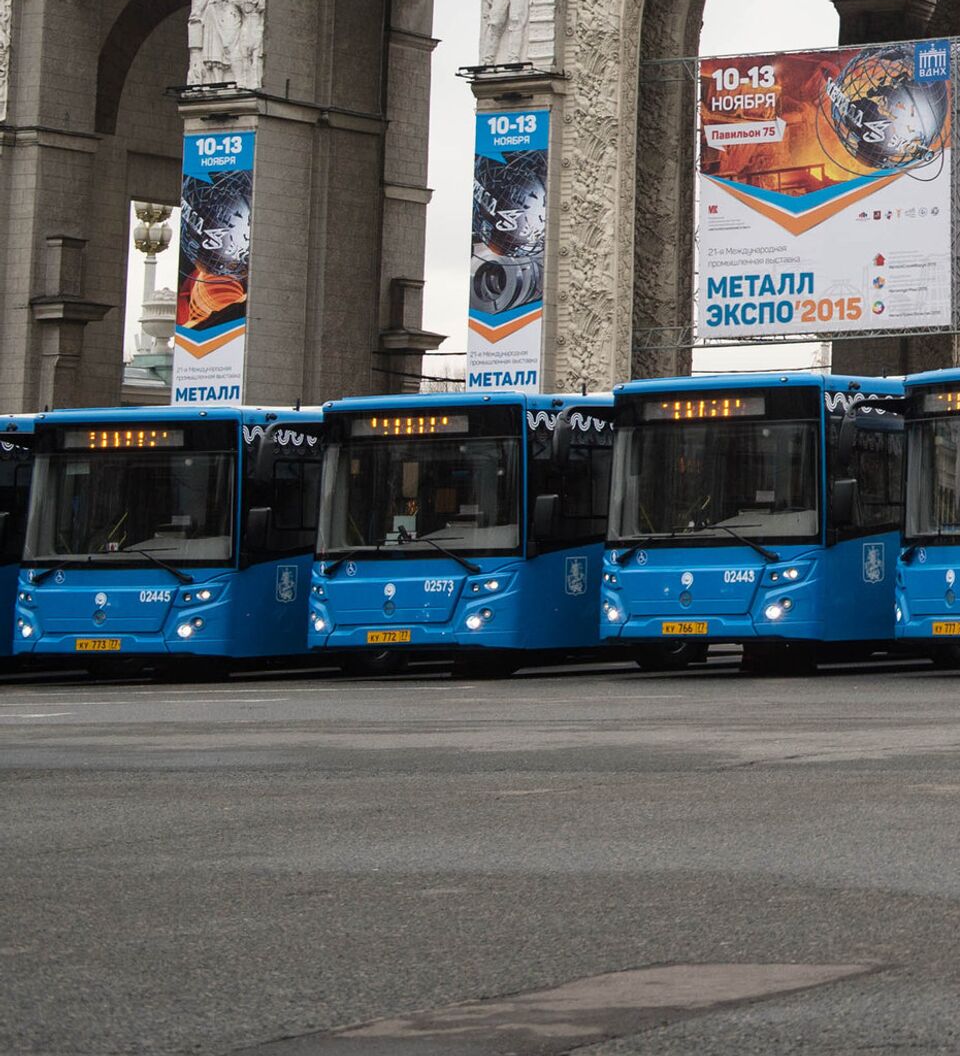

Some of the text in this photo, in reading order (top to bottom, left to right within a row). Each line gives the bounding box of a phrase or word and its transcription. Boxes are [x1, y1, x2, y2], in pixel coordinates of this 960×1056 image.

[712, 65, 775, 91] 10-13
[919, 69, 947, 77] ВДНХ
[712, 93, 776, 112] НОЯБРЯ
[488, 115, 537, 134] 10-13
[712, 127, 775, 140] Павильон 75
[196, 136, 242, 155] 10-13
[494, 136, 530, 146] НОЯБРЯ
[201, 156, 236, 166] НОЯБРЯ
[707, 272, 814, 299] МЕТАЛЛ
[469, 370, 537, 387] МЕТАЛЛ
[176, 385, 240, 402] МЕТАЛЛ
[724, 571, 755, 583] 02443
[424, 580, 454, 593] 02573
[139, 591, 170, 602] 02445
[679, 624, 692, 633] 766
[382, 632, 396, 642] 772
[92, 640, 106, 649] 773
